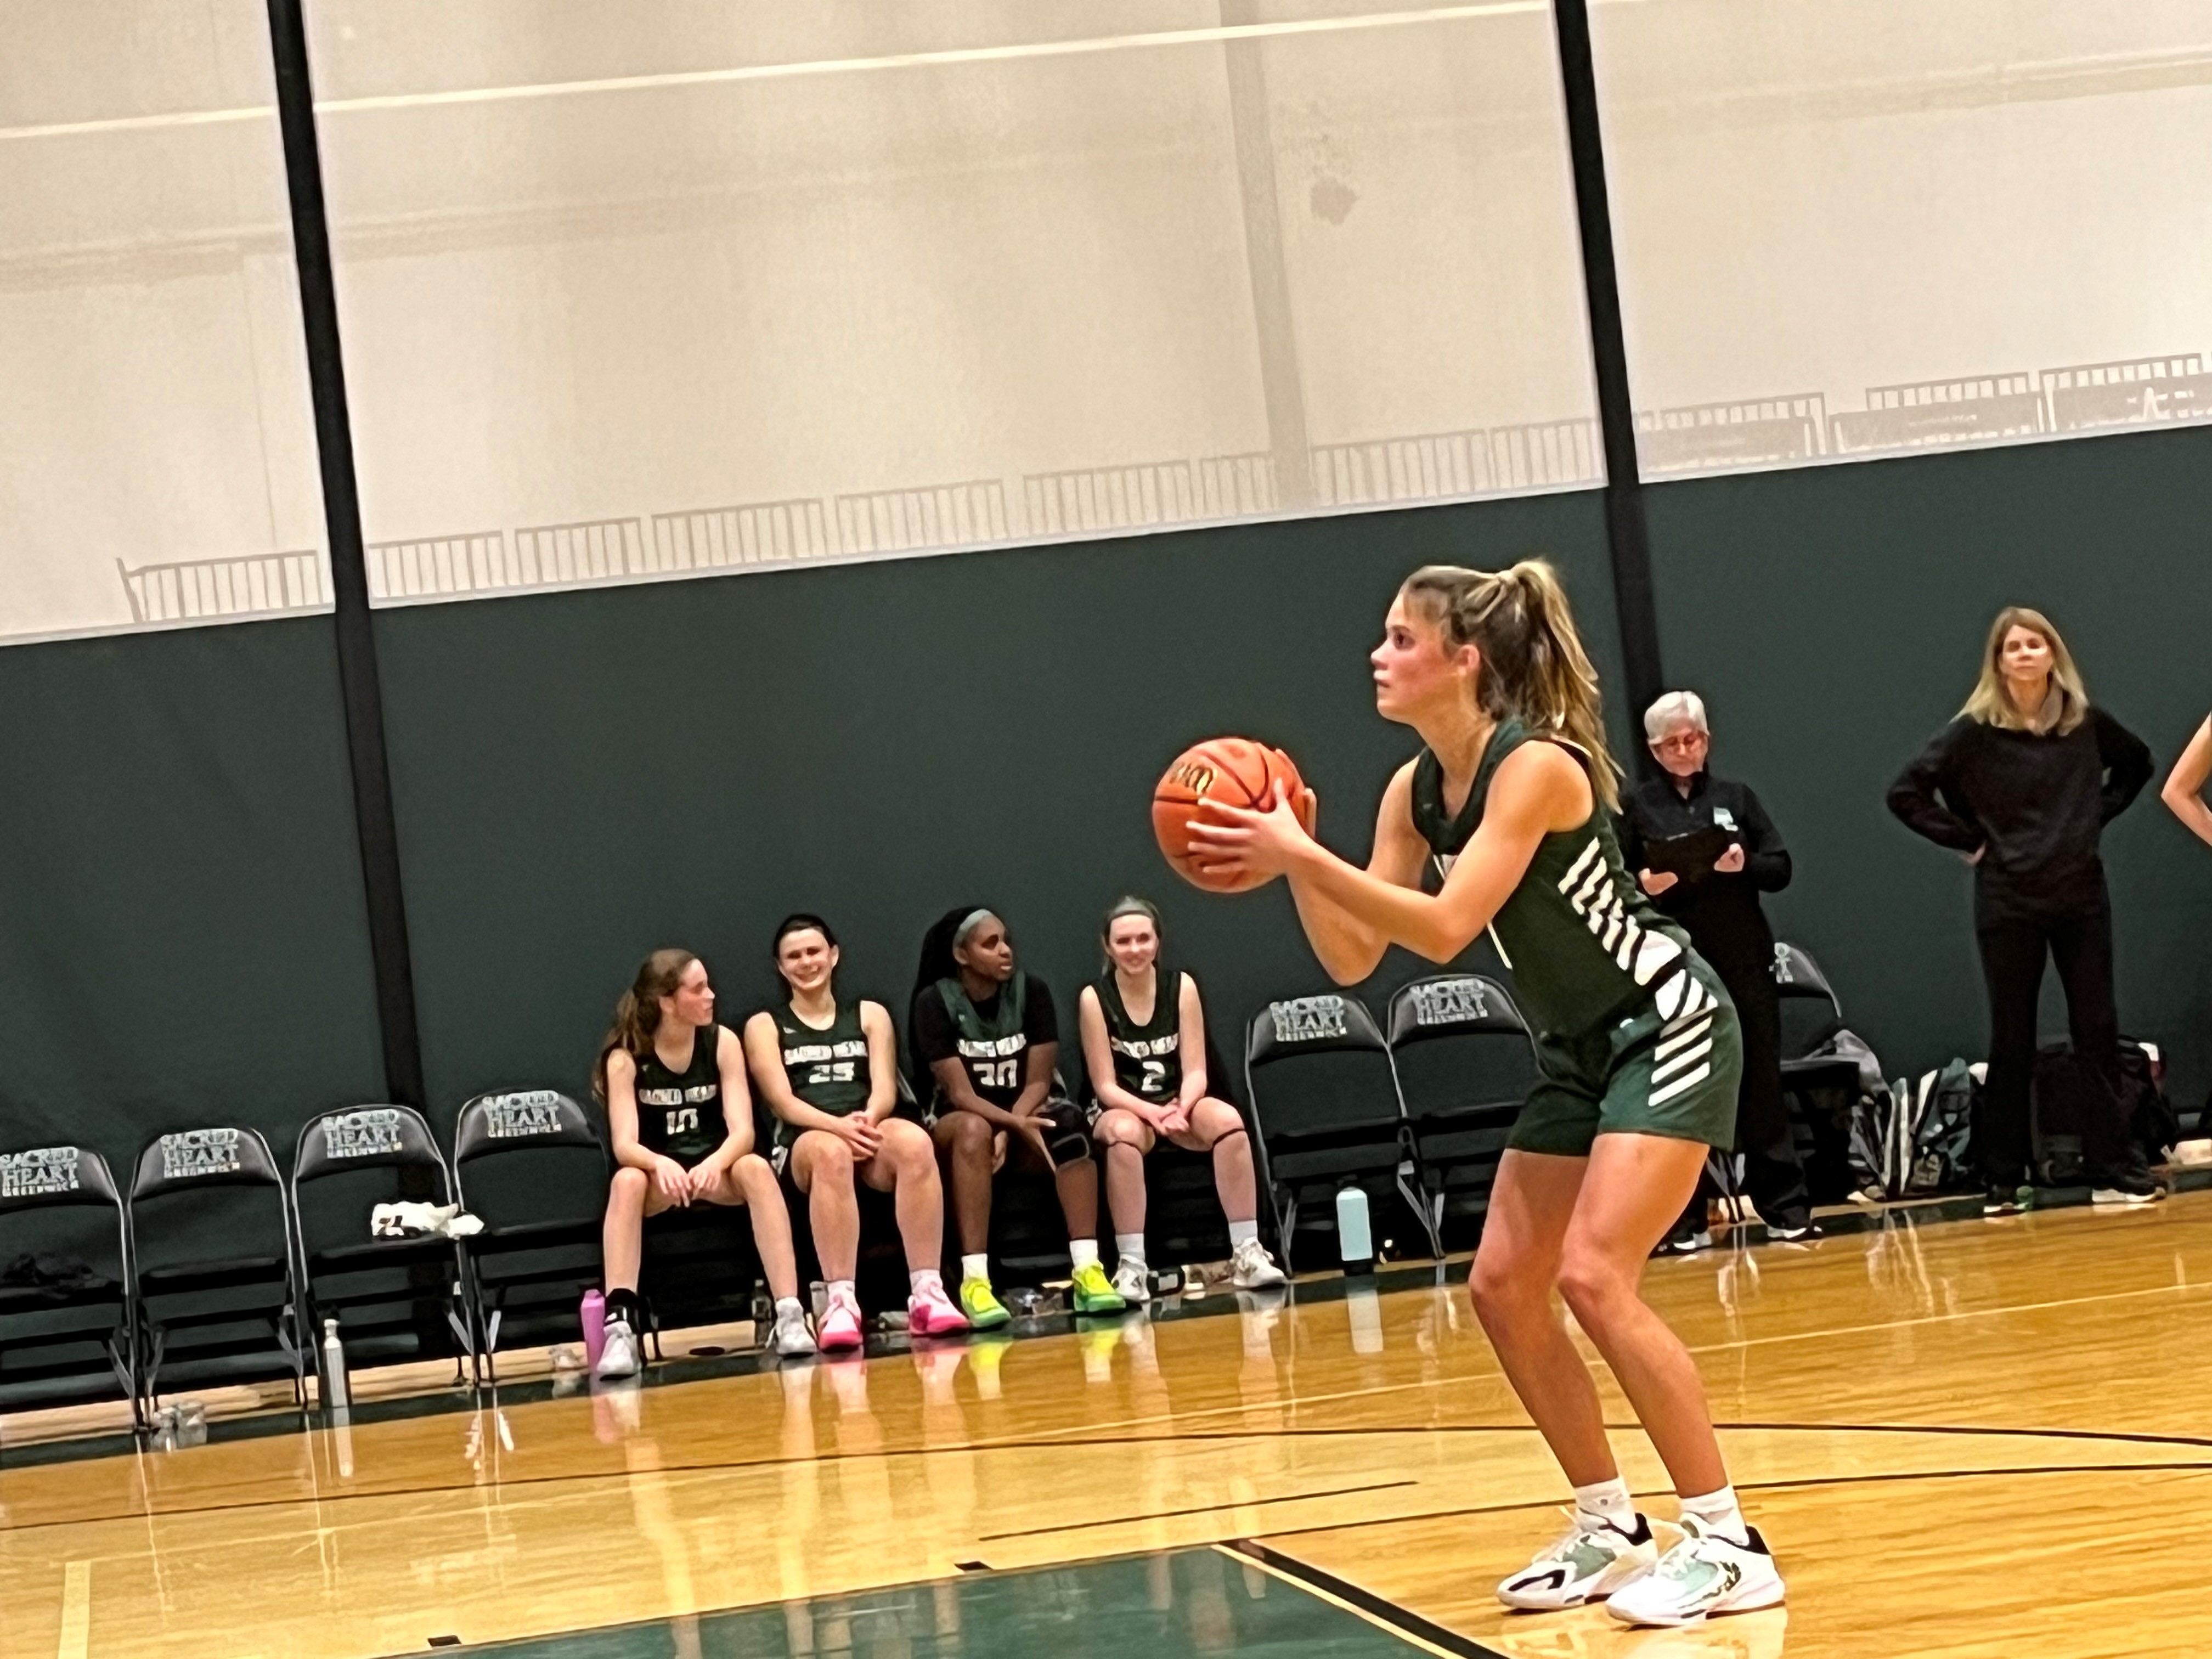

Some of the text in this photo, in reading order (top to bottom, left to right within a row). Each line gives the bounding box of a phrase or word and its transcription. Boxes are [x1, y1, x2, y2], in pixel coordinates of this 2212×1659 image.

[809, 1062, 855, 1084] 25
[973, 1059, 1017, 1088] 30
[1142, 1061, 1165, 1091] 2
[486, 1105, 560, 1130] HEART
[326, 1124, 400, 1148] HEART
[163, 1144, 239, 1169] HEART
[2, 1162, 77, 1186] HEART
